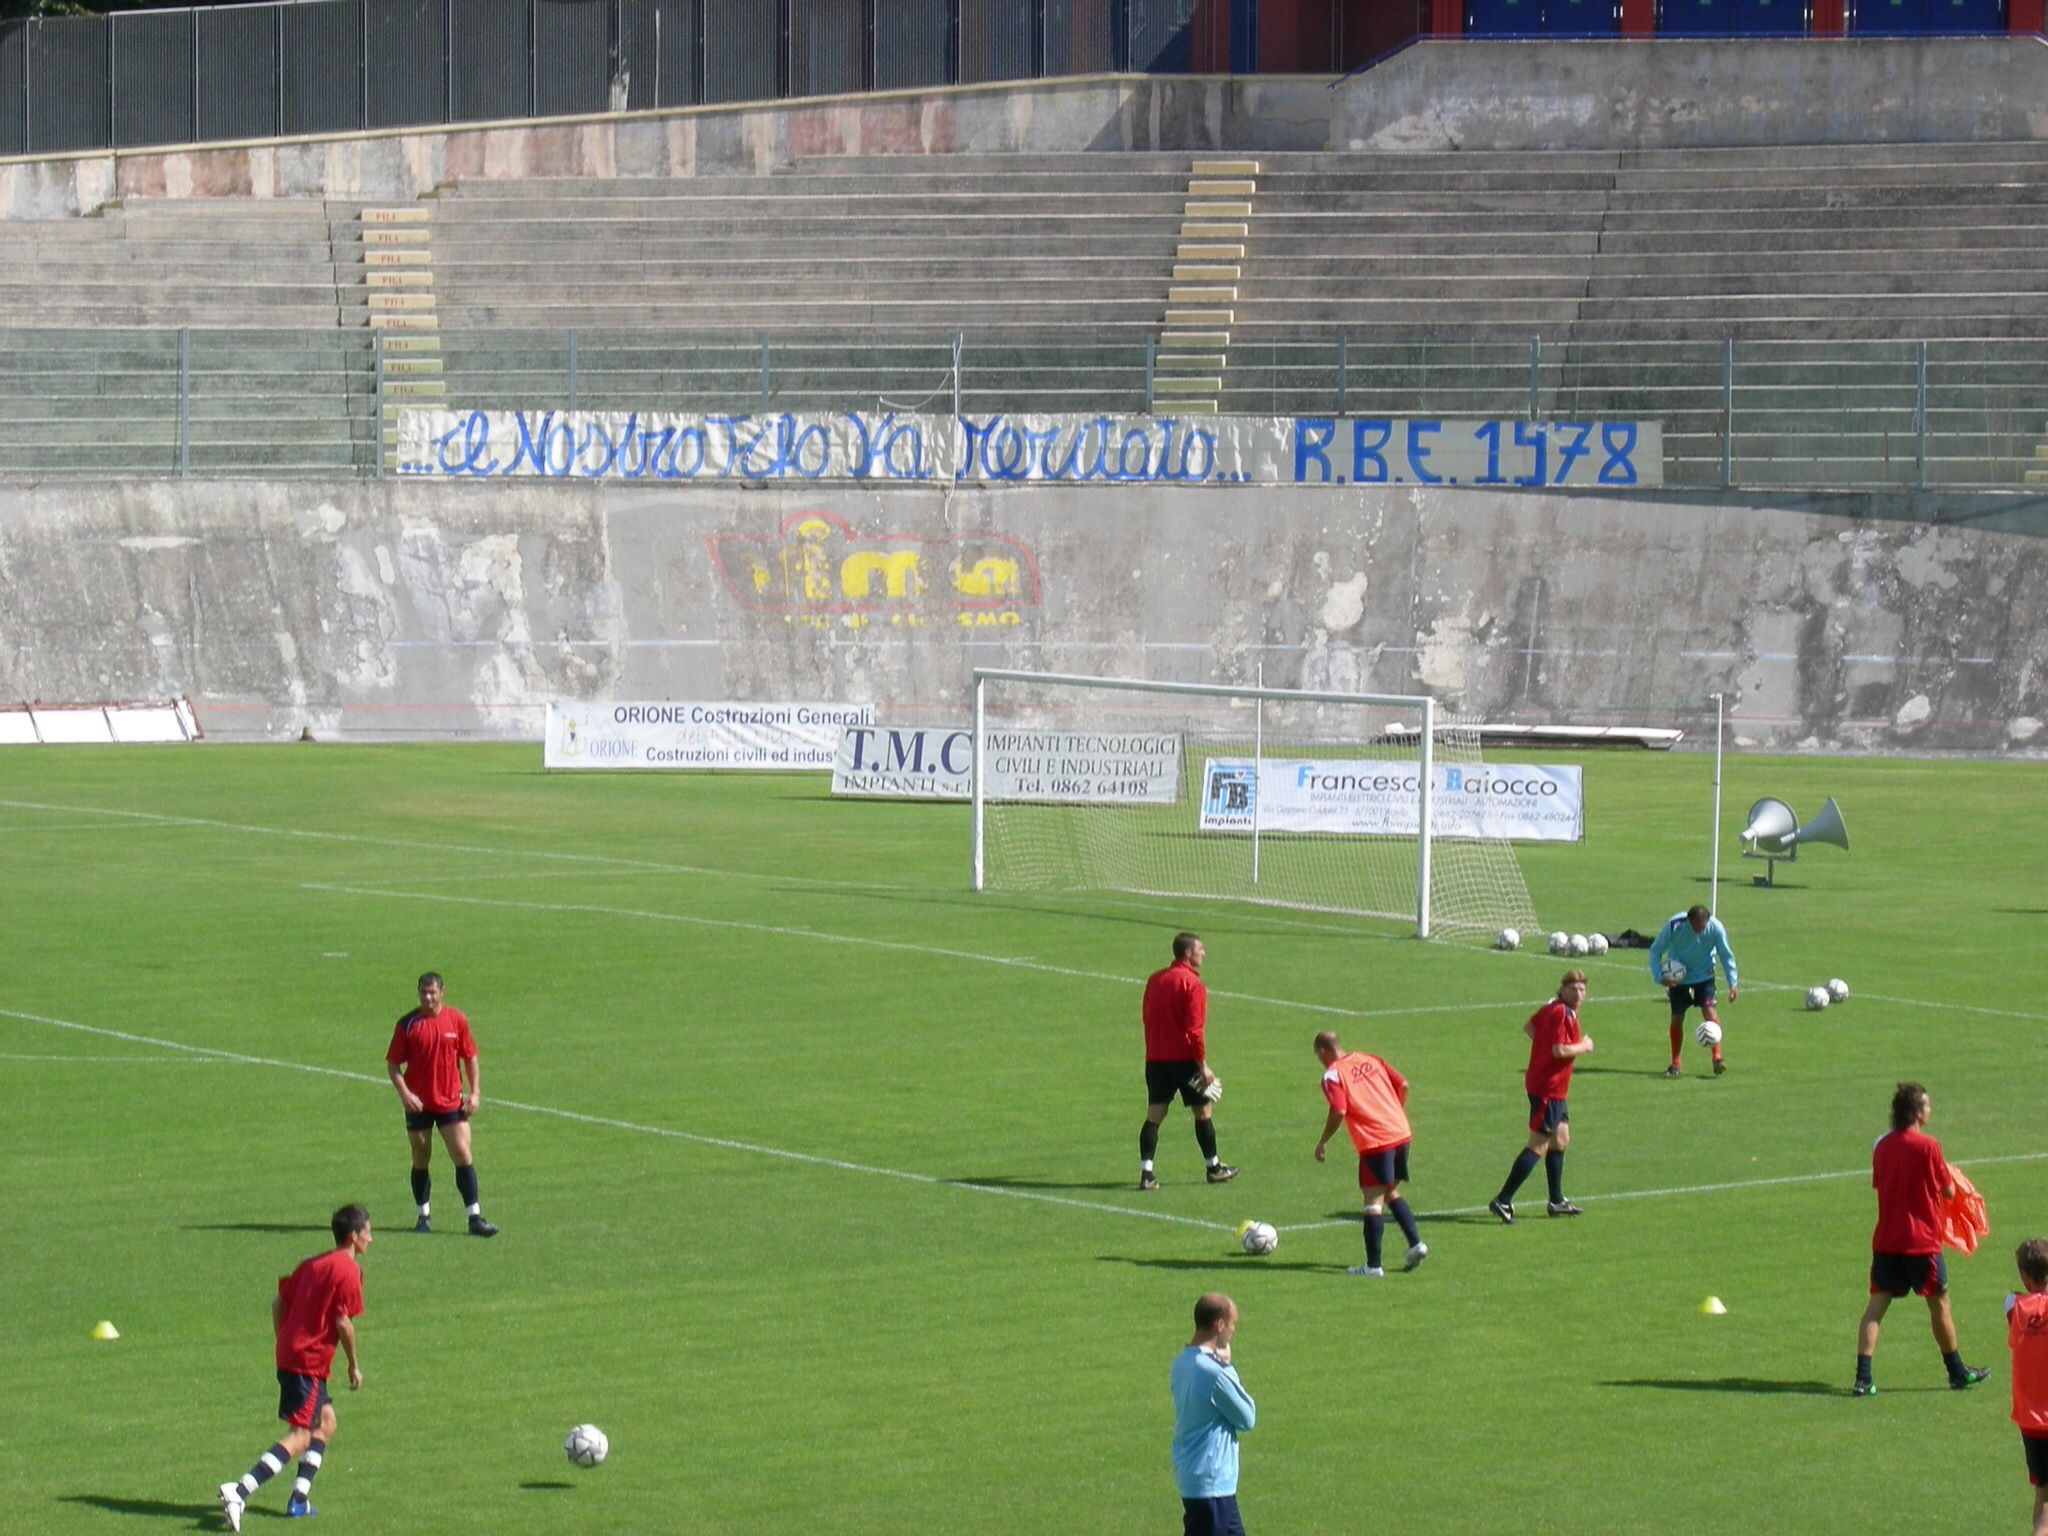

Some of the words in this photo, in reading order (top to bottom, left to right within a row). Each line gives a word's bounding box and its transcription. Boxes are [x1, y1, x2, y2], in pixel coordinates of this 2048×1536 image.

[502, 411, 706, 479] Nostro
[846, 412, 932, 479] Va
[1474, 419, 1638, 486] 1978
[614, 706, 685, 724] ORIONE
[691, 706, 791, 725] Costruzioni
[797, 707, 870, 726] Generali
[589, 739, 639, 758] ORIONE
[646, 746, 729, 762] Costruzioni
[733, 747, 767, 762] civili
[771, 747, 789, 762] ed
[986, 733, 1060, 752] IMPIANTI
[1066, 735, 1177, 756] TECNOLOGICI
[995, 757, 1041, 774] CIVILI
[1046, 758, 1055, 775] E
[1060, 758, 1164, 777] INDUSTRIALI
[843, 775, 935, 793] IMPIANTI
[1016, 777, 1044, 794] Tel.
[1051, 779, 1091, 795] 0862
[1097, 779, 1149, 797] 64108
[1445, 767, 1559, 797] Baiocco
[1310, 792, 1346, 803] IMPIANTI
[1474, 797, 1538, 808] AUTOMAZIONI
[1204, 814, 1252, 827] impianti
